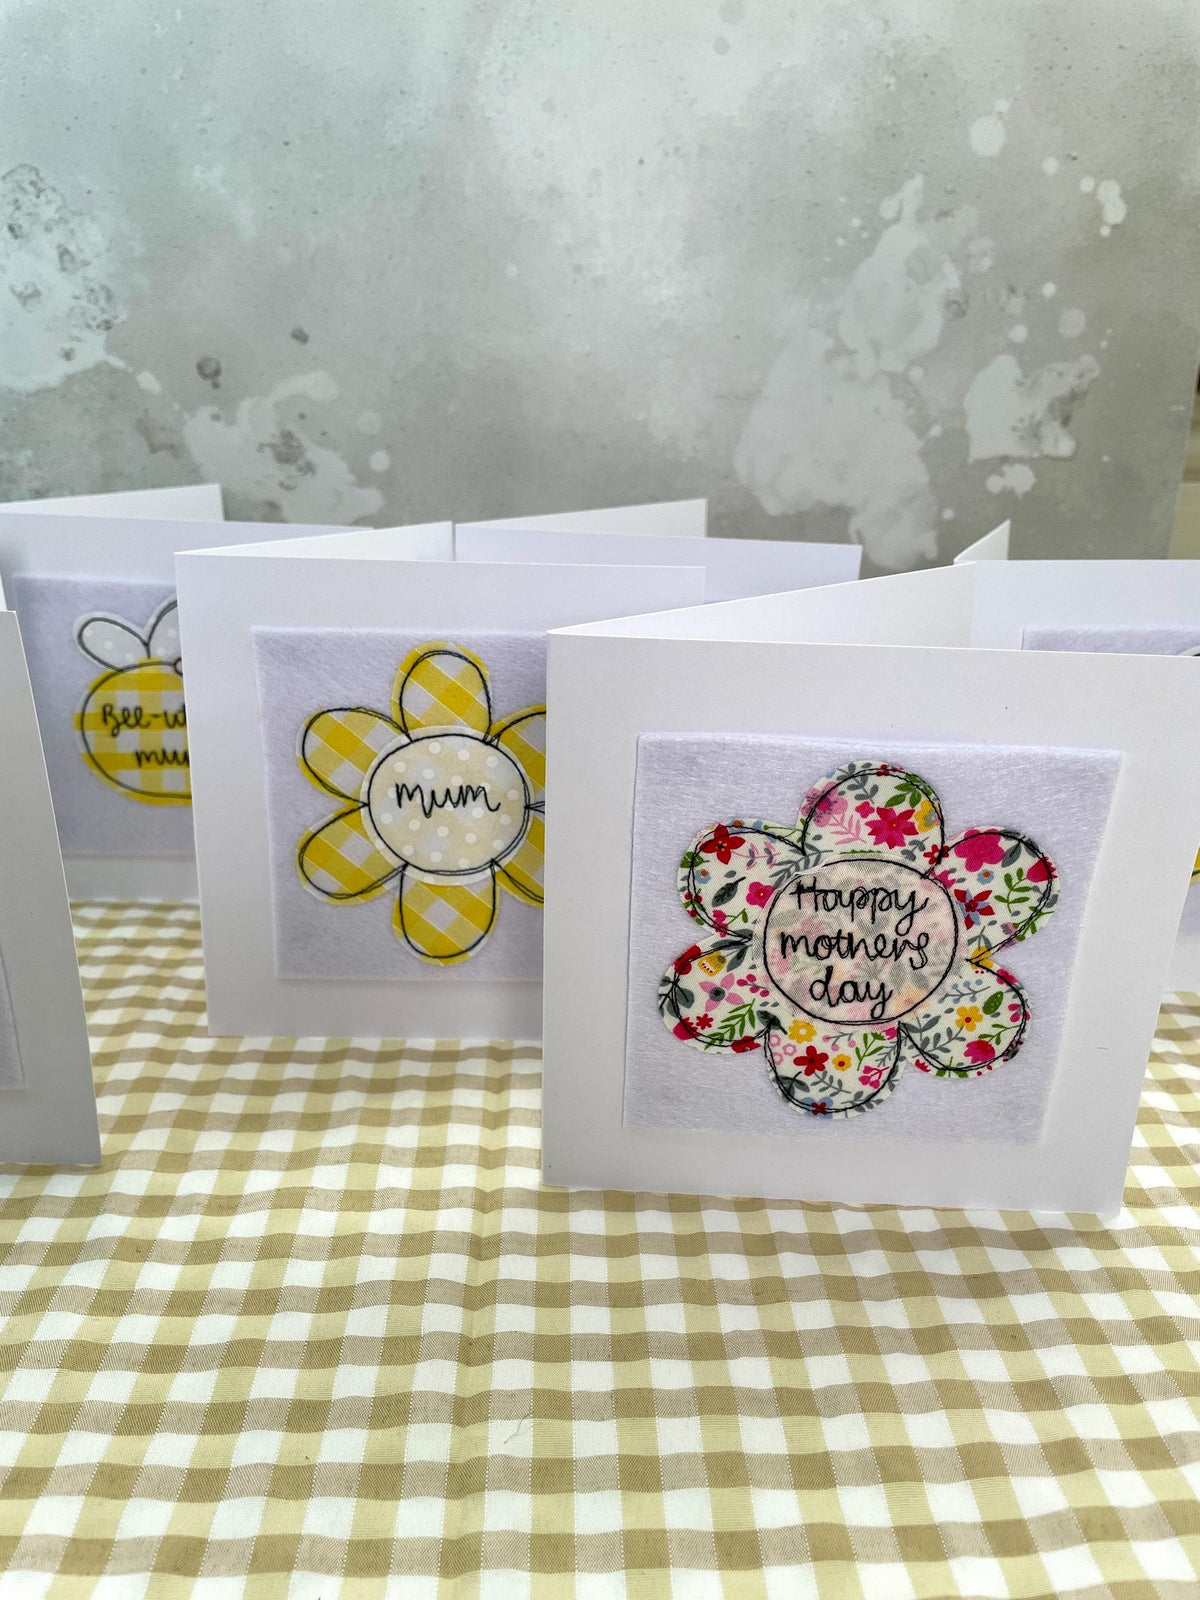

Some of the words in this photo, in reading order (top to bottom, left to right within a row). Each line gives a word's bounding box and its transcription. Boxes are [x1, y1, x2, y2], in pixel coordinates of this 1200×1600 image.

[134, 748, 190, 769] mu
[395, 782, 502, 819] mum
[789, 876, 929, 936] Happy
[780, 929, 930, 970] mothers
[809, 965, 893, 1020] day
